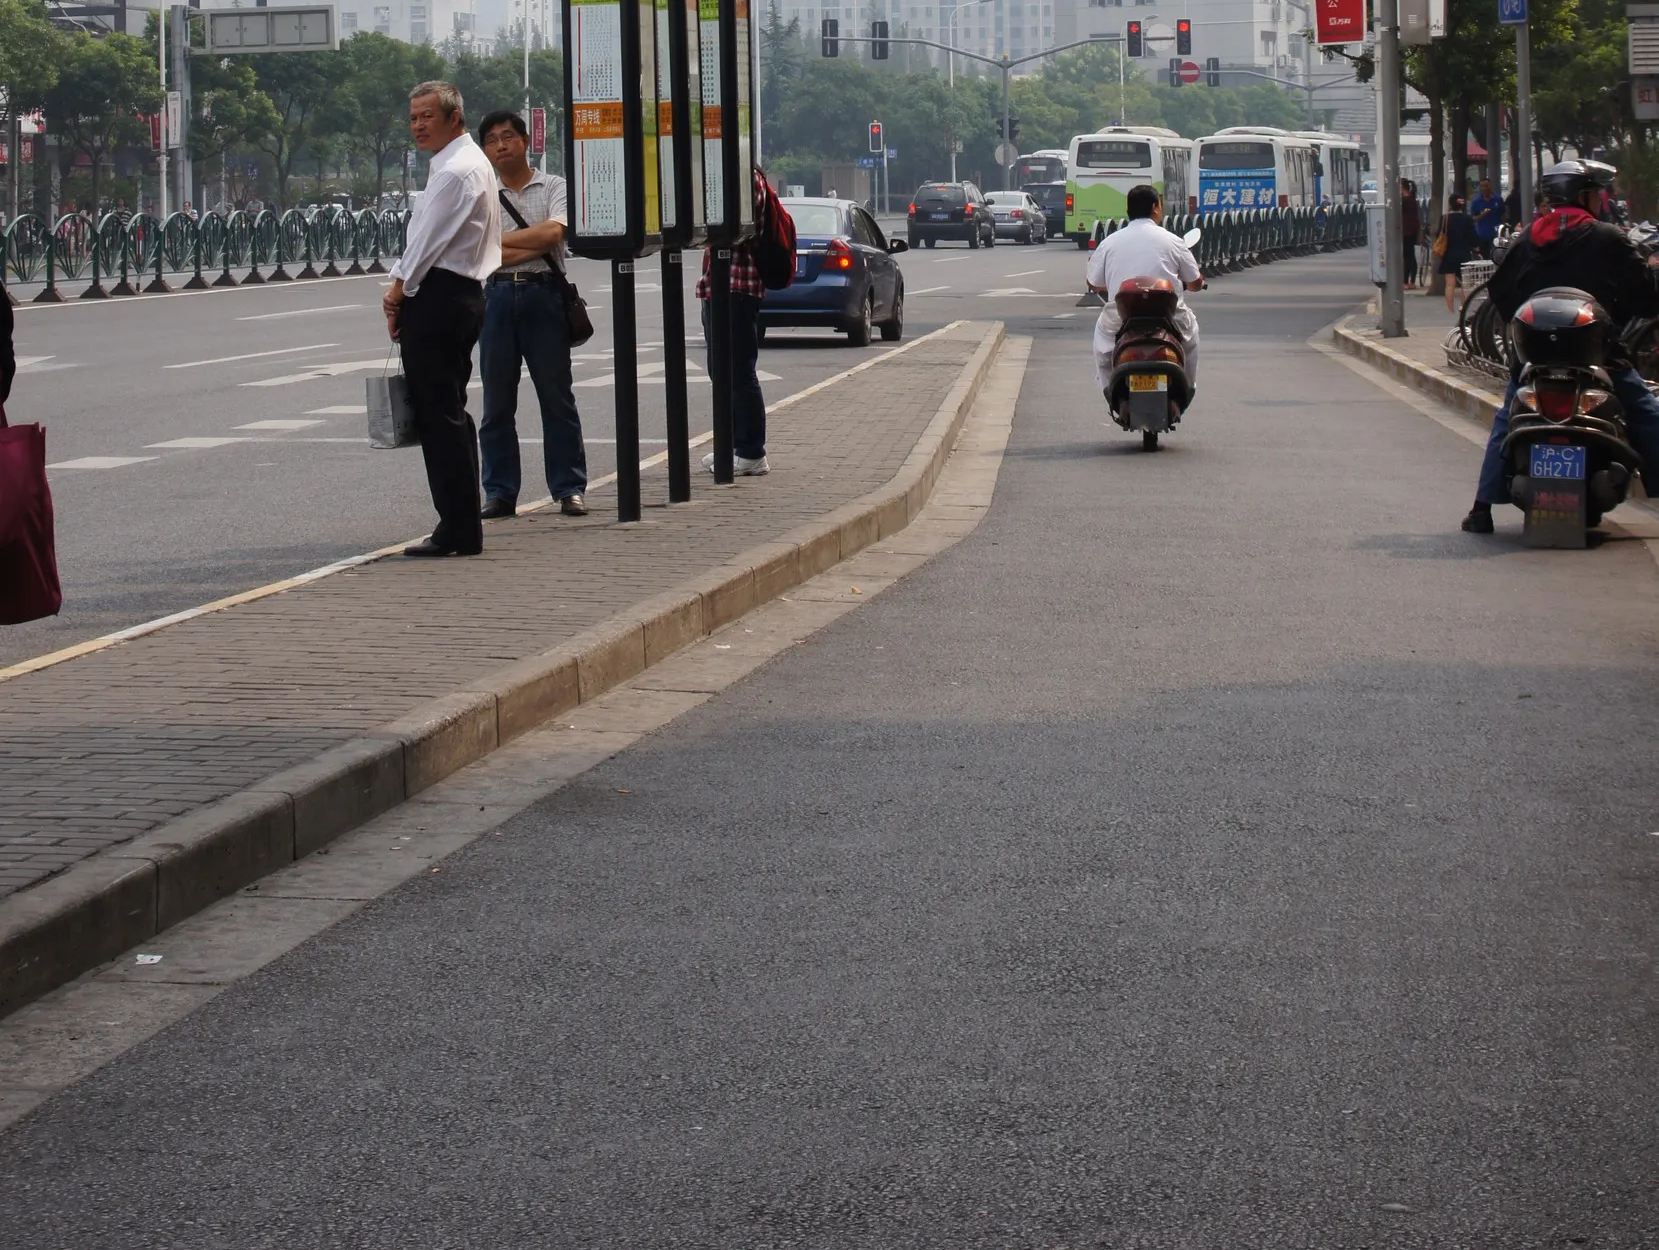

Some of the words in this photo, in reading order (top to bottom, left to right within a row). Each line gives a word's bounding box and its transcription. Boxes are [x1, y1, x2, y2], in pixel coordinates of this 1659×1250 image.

[574, 108, 600, 126] 万周专线
[1203, 188, 1275, 206] 恒大建材
[1533, 461, 1580, 477] GH271
